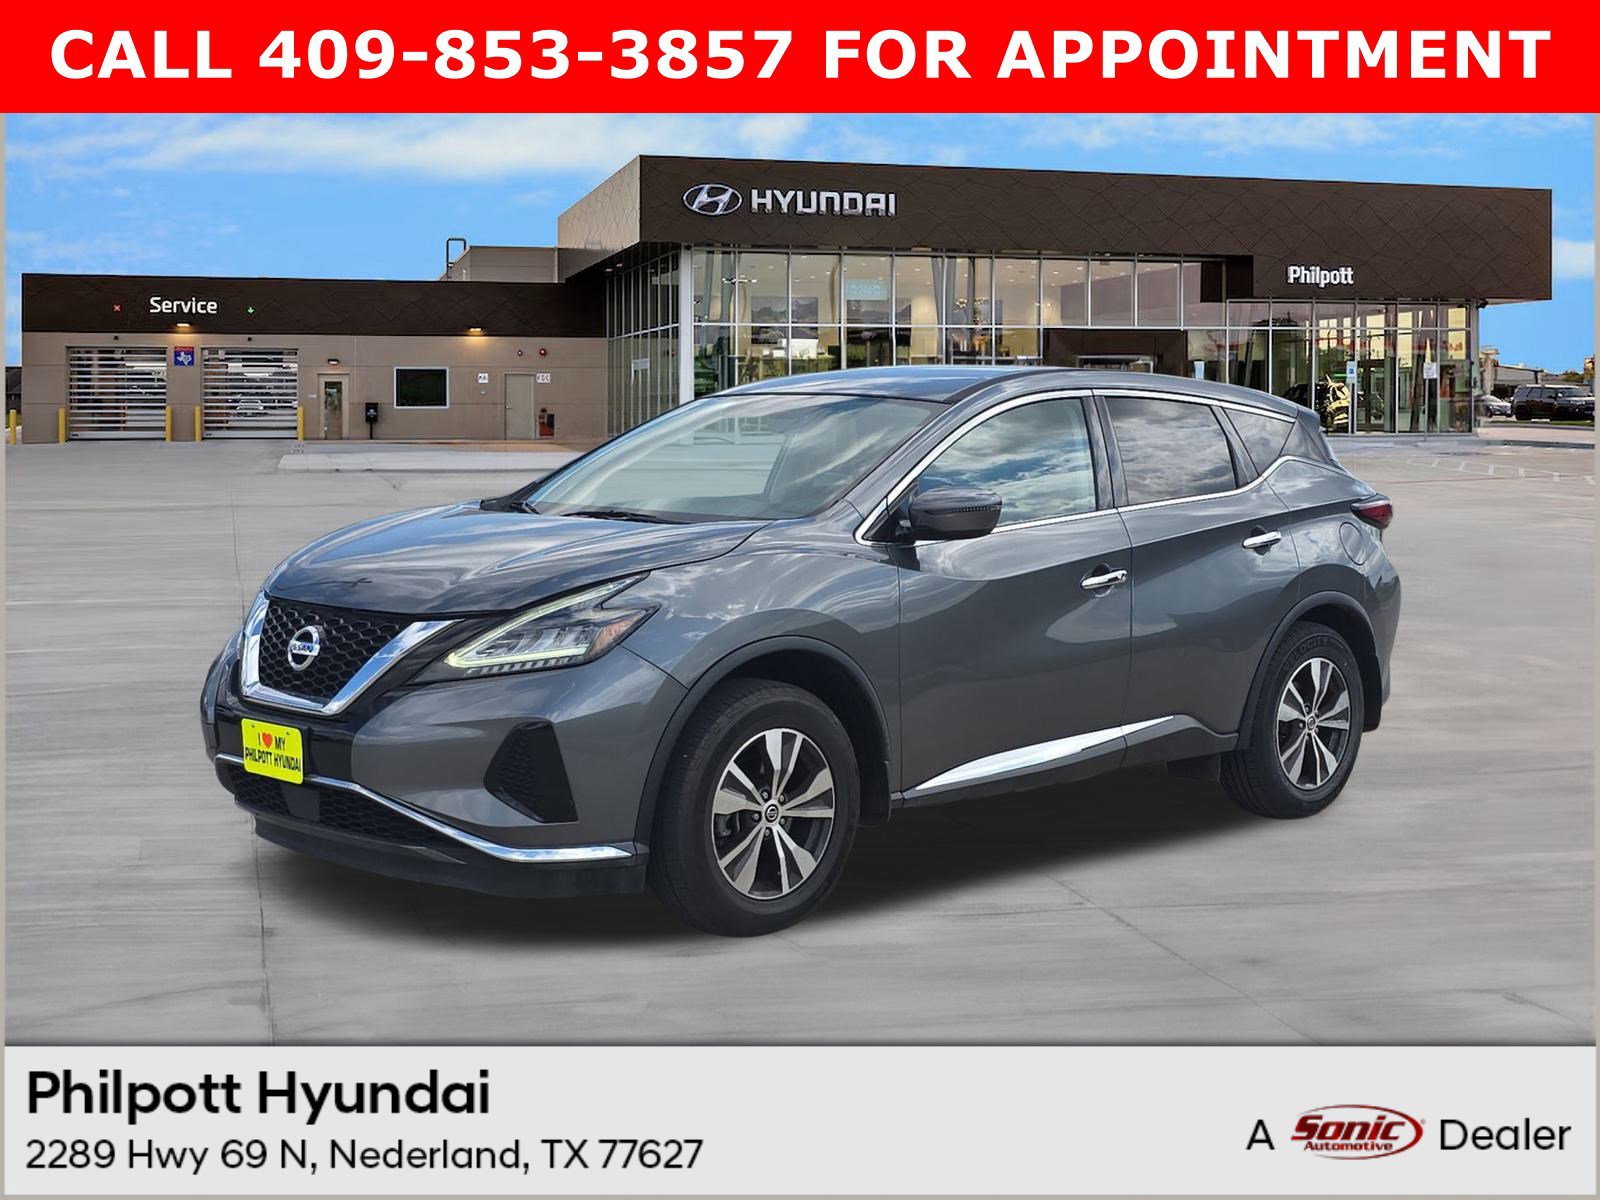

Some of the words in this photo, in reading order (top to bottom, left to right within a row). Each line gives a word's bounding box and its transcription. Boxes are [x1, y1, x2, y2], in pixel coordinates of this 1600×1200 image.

[751, 188, 896, 217] HYUNDAI
[1287, 265, 1354, 288] Philpott
[149, 296, 218, 314] Service
[274, 735, 286, 751] MY
[245, 746, 273, 766] PHILPOTT
[274, 752, 301, 772] HYUNDAI
